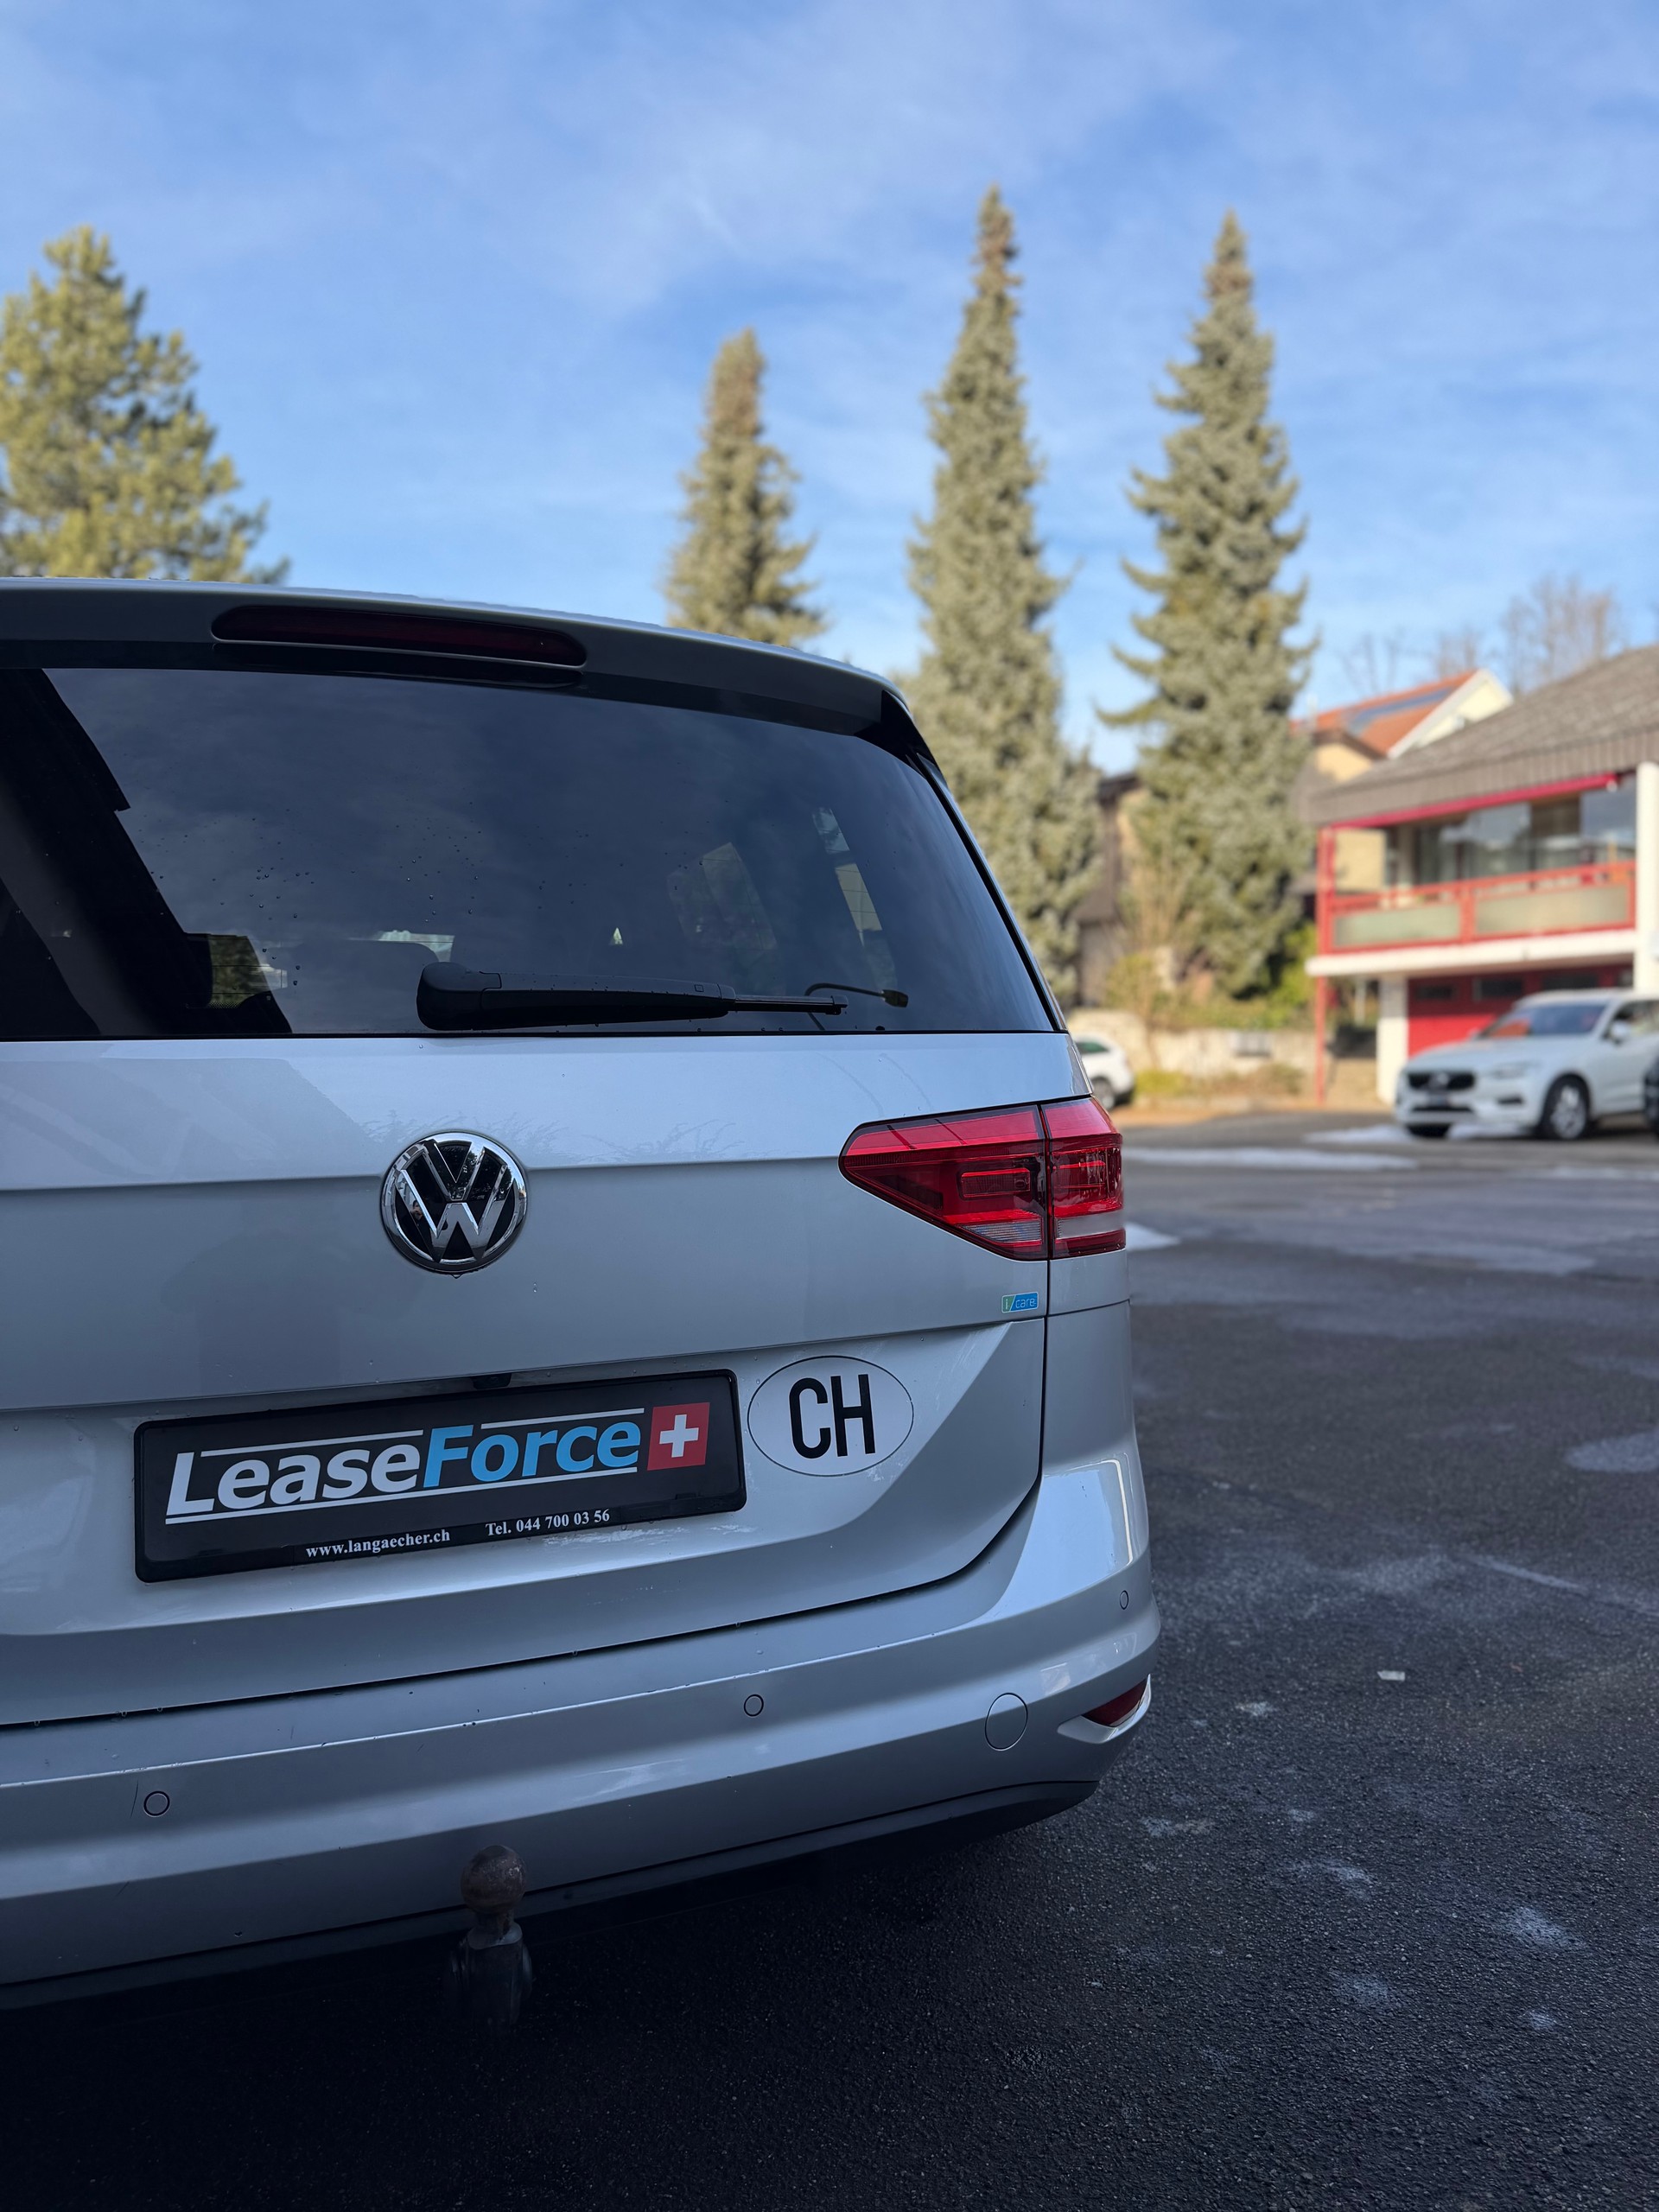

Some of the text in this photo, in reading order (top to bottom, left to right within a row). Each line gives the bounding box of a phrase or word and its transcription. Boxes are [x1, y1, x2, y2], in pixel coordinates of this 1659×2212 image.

[386, 1135, 523, 1268] VW
[1014, 1298, 1037, 1309] care
[788, 1373, 876, 1459] CH
[166, 1420, 642, 1516] LeaseForce
[305, 1529, 451, 1558] www.langaecher.ch
[485, 1508, 611, 1536] Tel. 044 700 03 56
